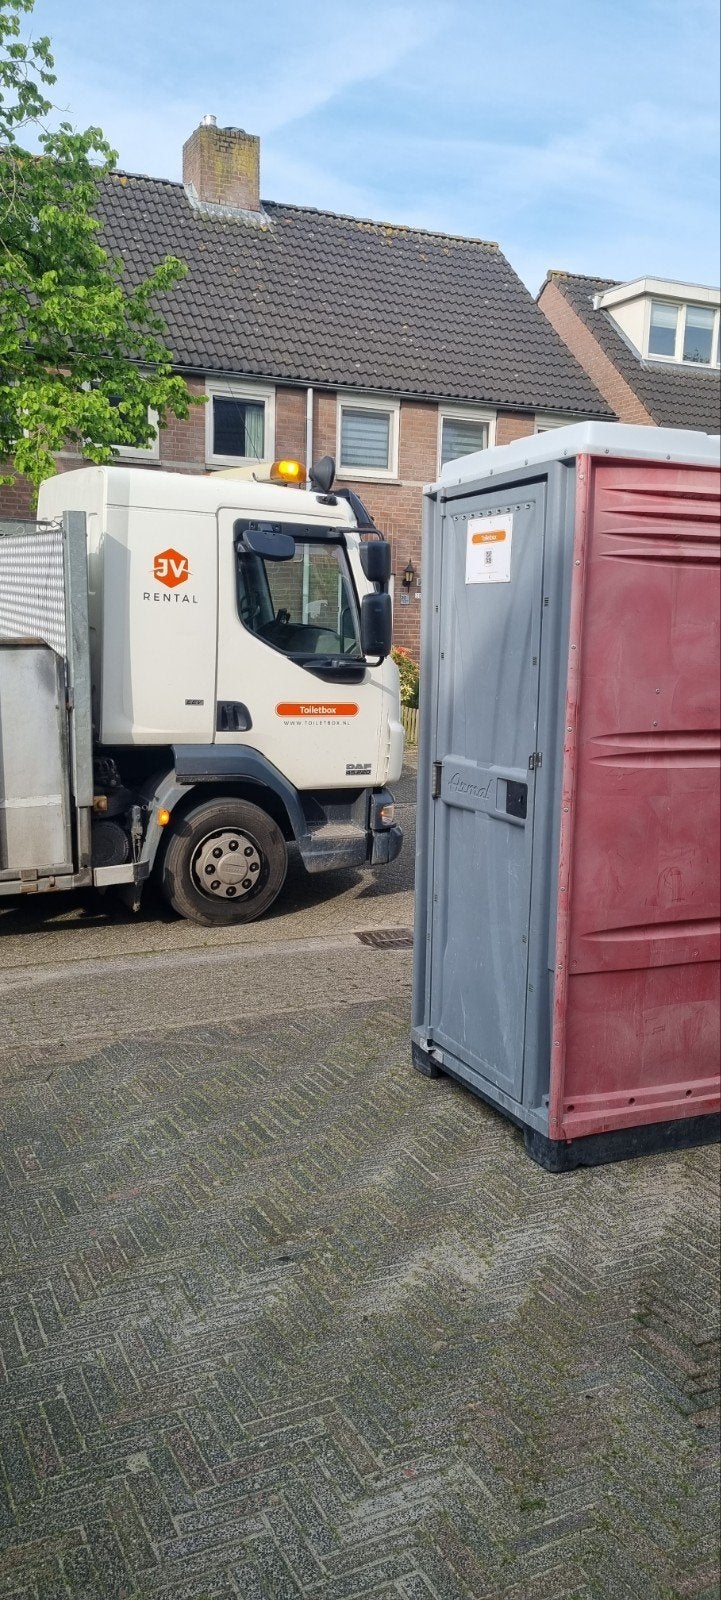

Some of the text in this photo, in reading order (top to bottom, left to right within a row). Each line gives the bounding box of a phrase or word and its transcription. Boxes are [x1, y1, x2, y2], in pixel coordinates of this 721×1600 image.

[156, 558, 186, 578] JV
[143, 592, 198, 604] RENTAL
[299, 706, 337, 714] Toiletbox
